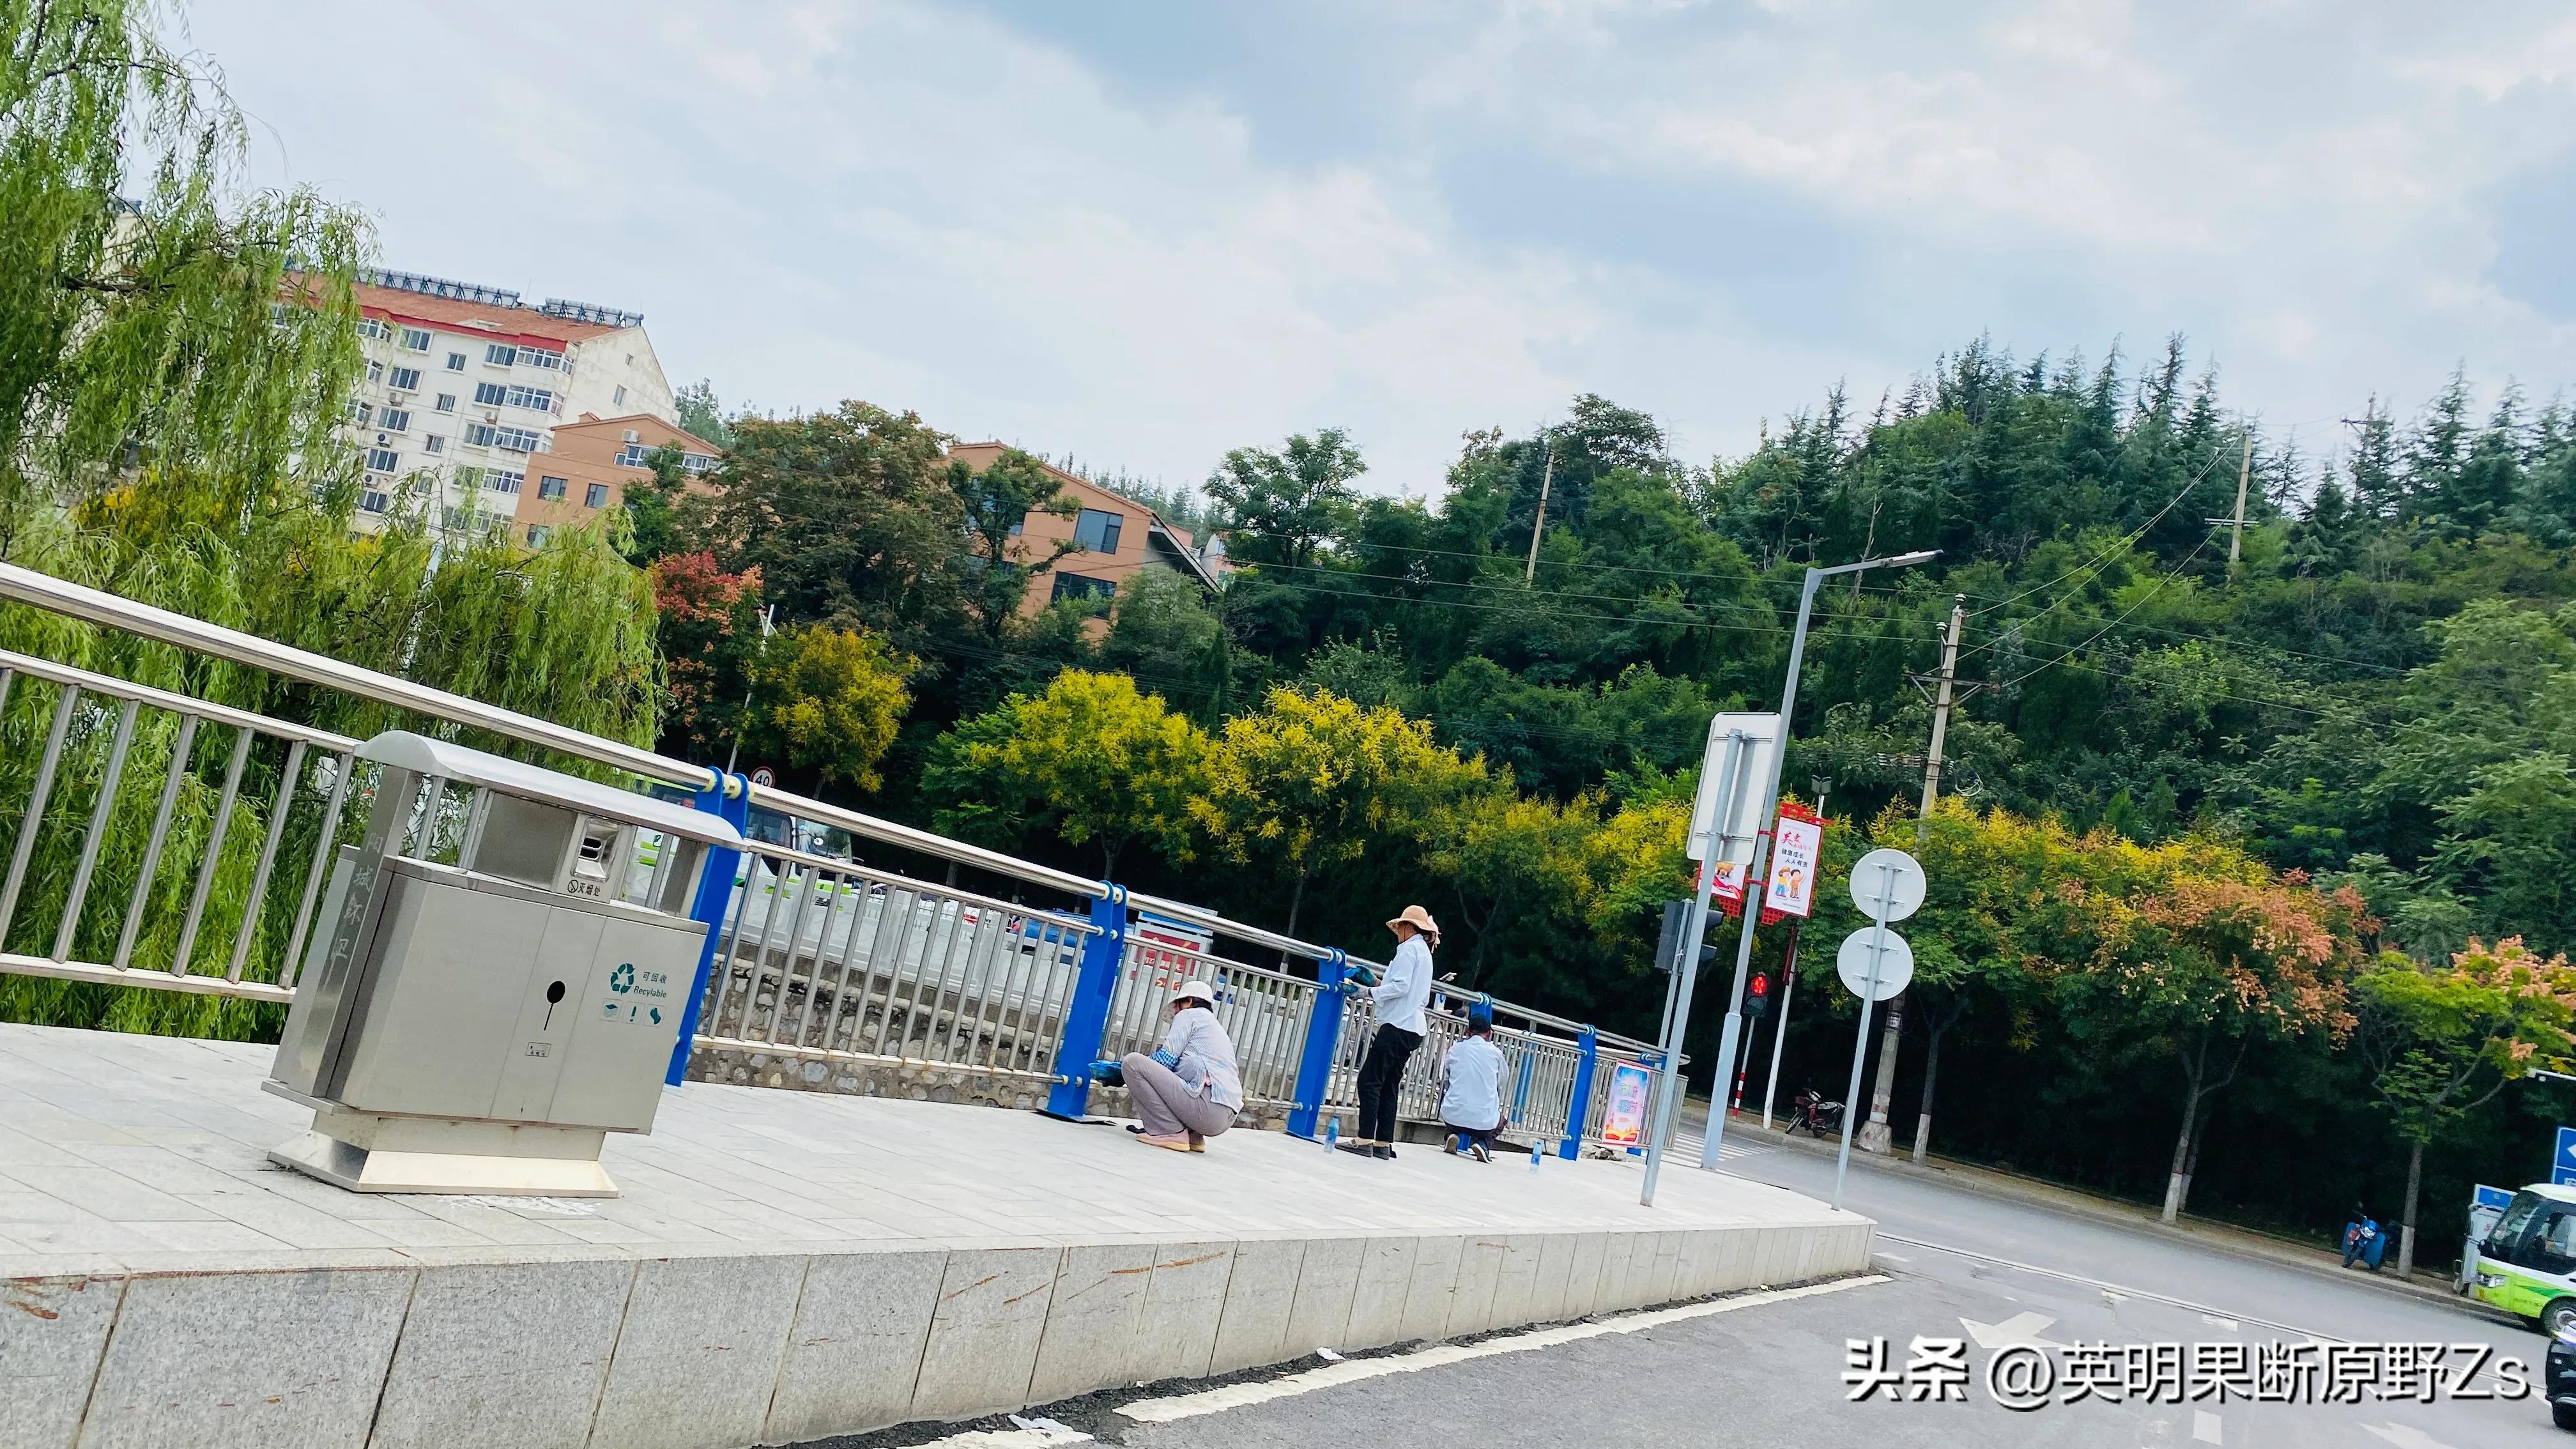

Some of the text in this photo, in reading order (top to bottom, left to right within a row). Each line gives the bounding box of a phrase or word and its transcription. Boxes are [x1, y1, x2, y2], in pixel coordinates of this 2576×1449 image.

[755, 774, 770, 787] 40
[1781, 848, 1804, 859] 健康成长
[1784, 857, 1808, 868] 人人有责
[577, 882, 601, 897] 灭烟处
[643, 971, 668, 985] 可回收
[633, 985, 667, 998] Recylable
